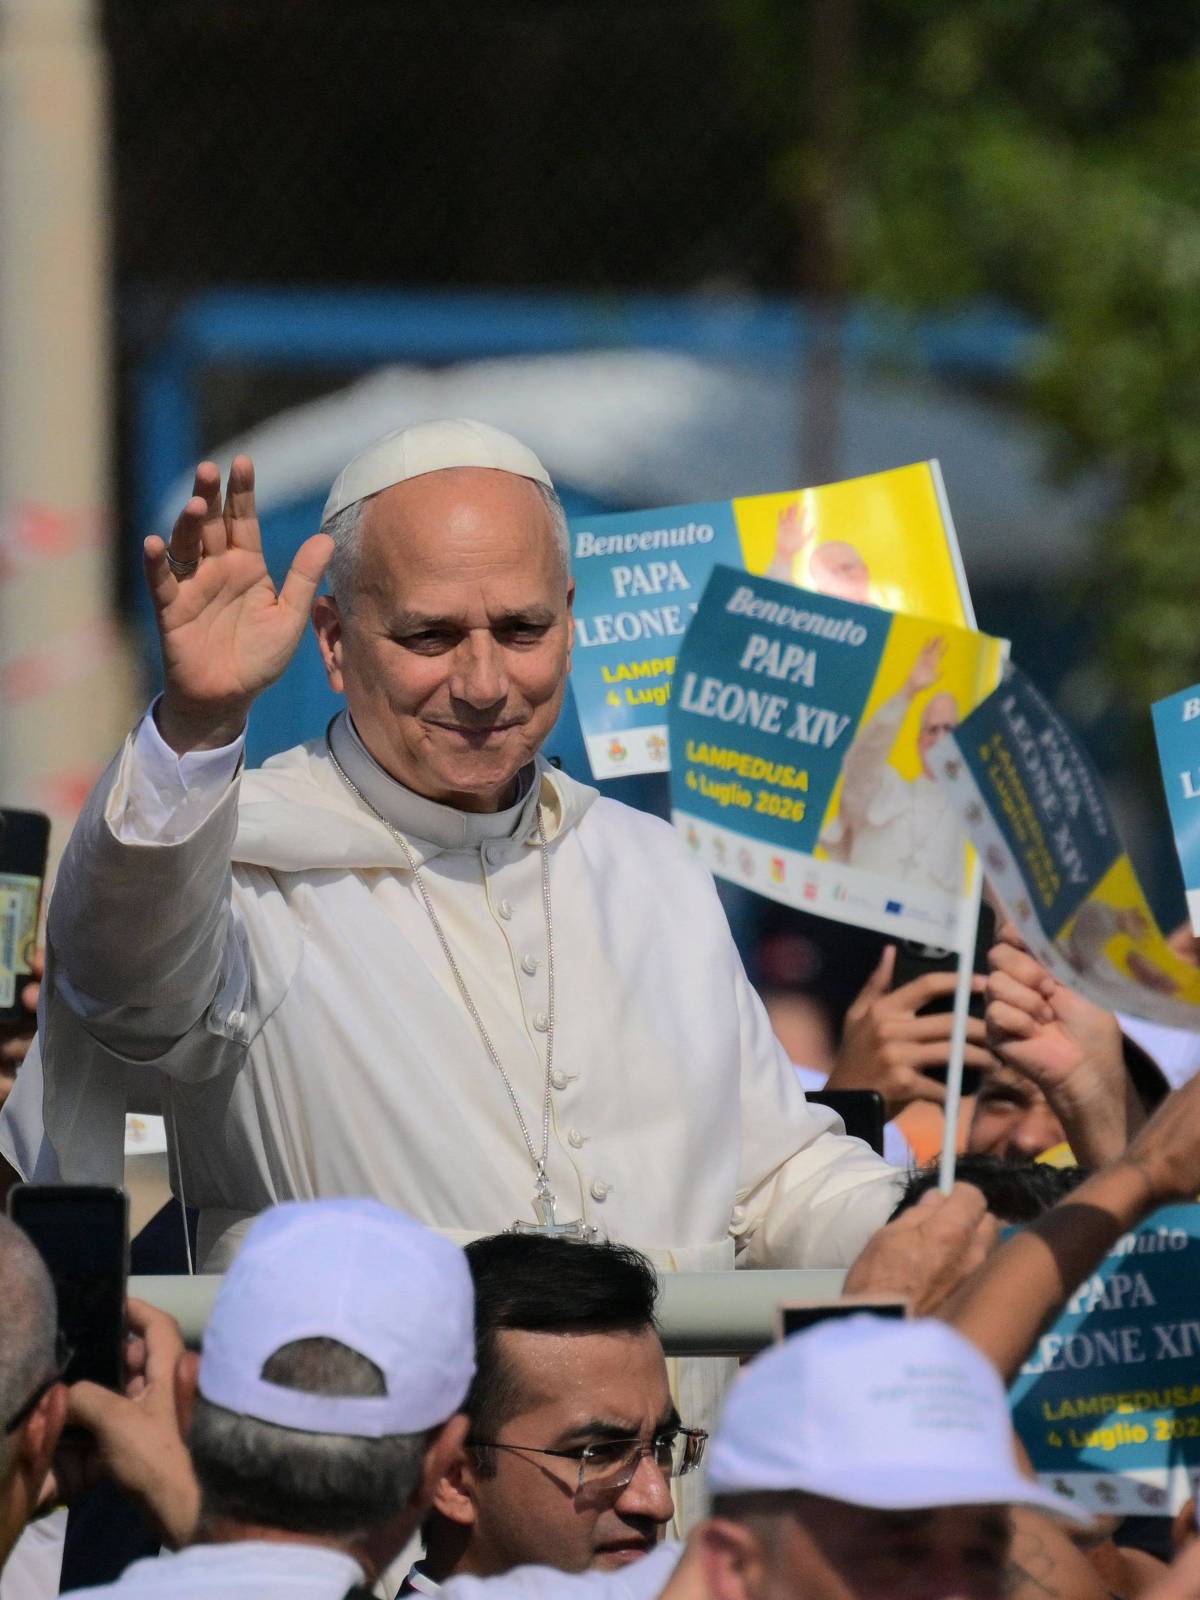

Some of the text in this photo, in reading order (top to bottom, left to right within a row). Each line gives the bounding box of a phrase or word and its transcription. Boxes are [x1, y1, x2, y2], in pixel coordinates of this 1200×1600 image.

[575, 522, 714, 558] Benvenuto
[611, 560, 691, 598] PAPA
[575, 605, 687, 647] LEONE
[726, 585, 868, 647] Benvenuto
[602, 655, 676, 683] LAMPE
[739, 633, 818, 688] PAPA
[606, 682, 672, 706] 4 Lugl
[679, 671, 851, 750] LEONE XIV
[685, 739, 809, 792] LAMPEDUSA
[685, 771, 806, 823] 4 Luglio 2026
[1068, 1272, 1157, 1315] PAPA
[1048, 1430, 1063, 1448] 4
[1070, 1421, 1149, 1452] Luglio
